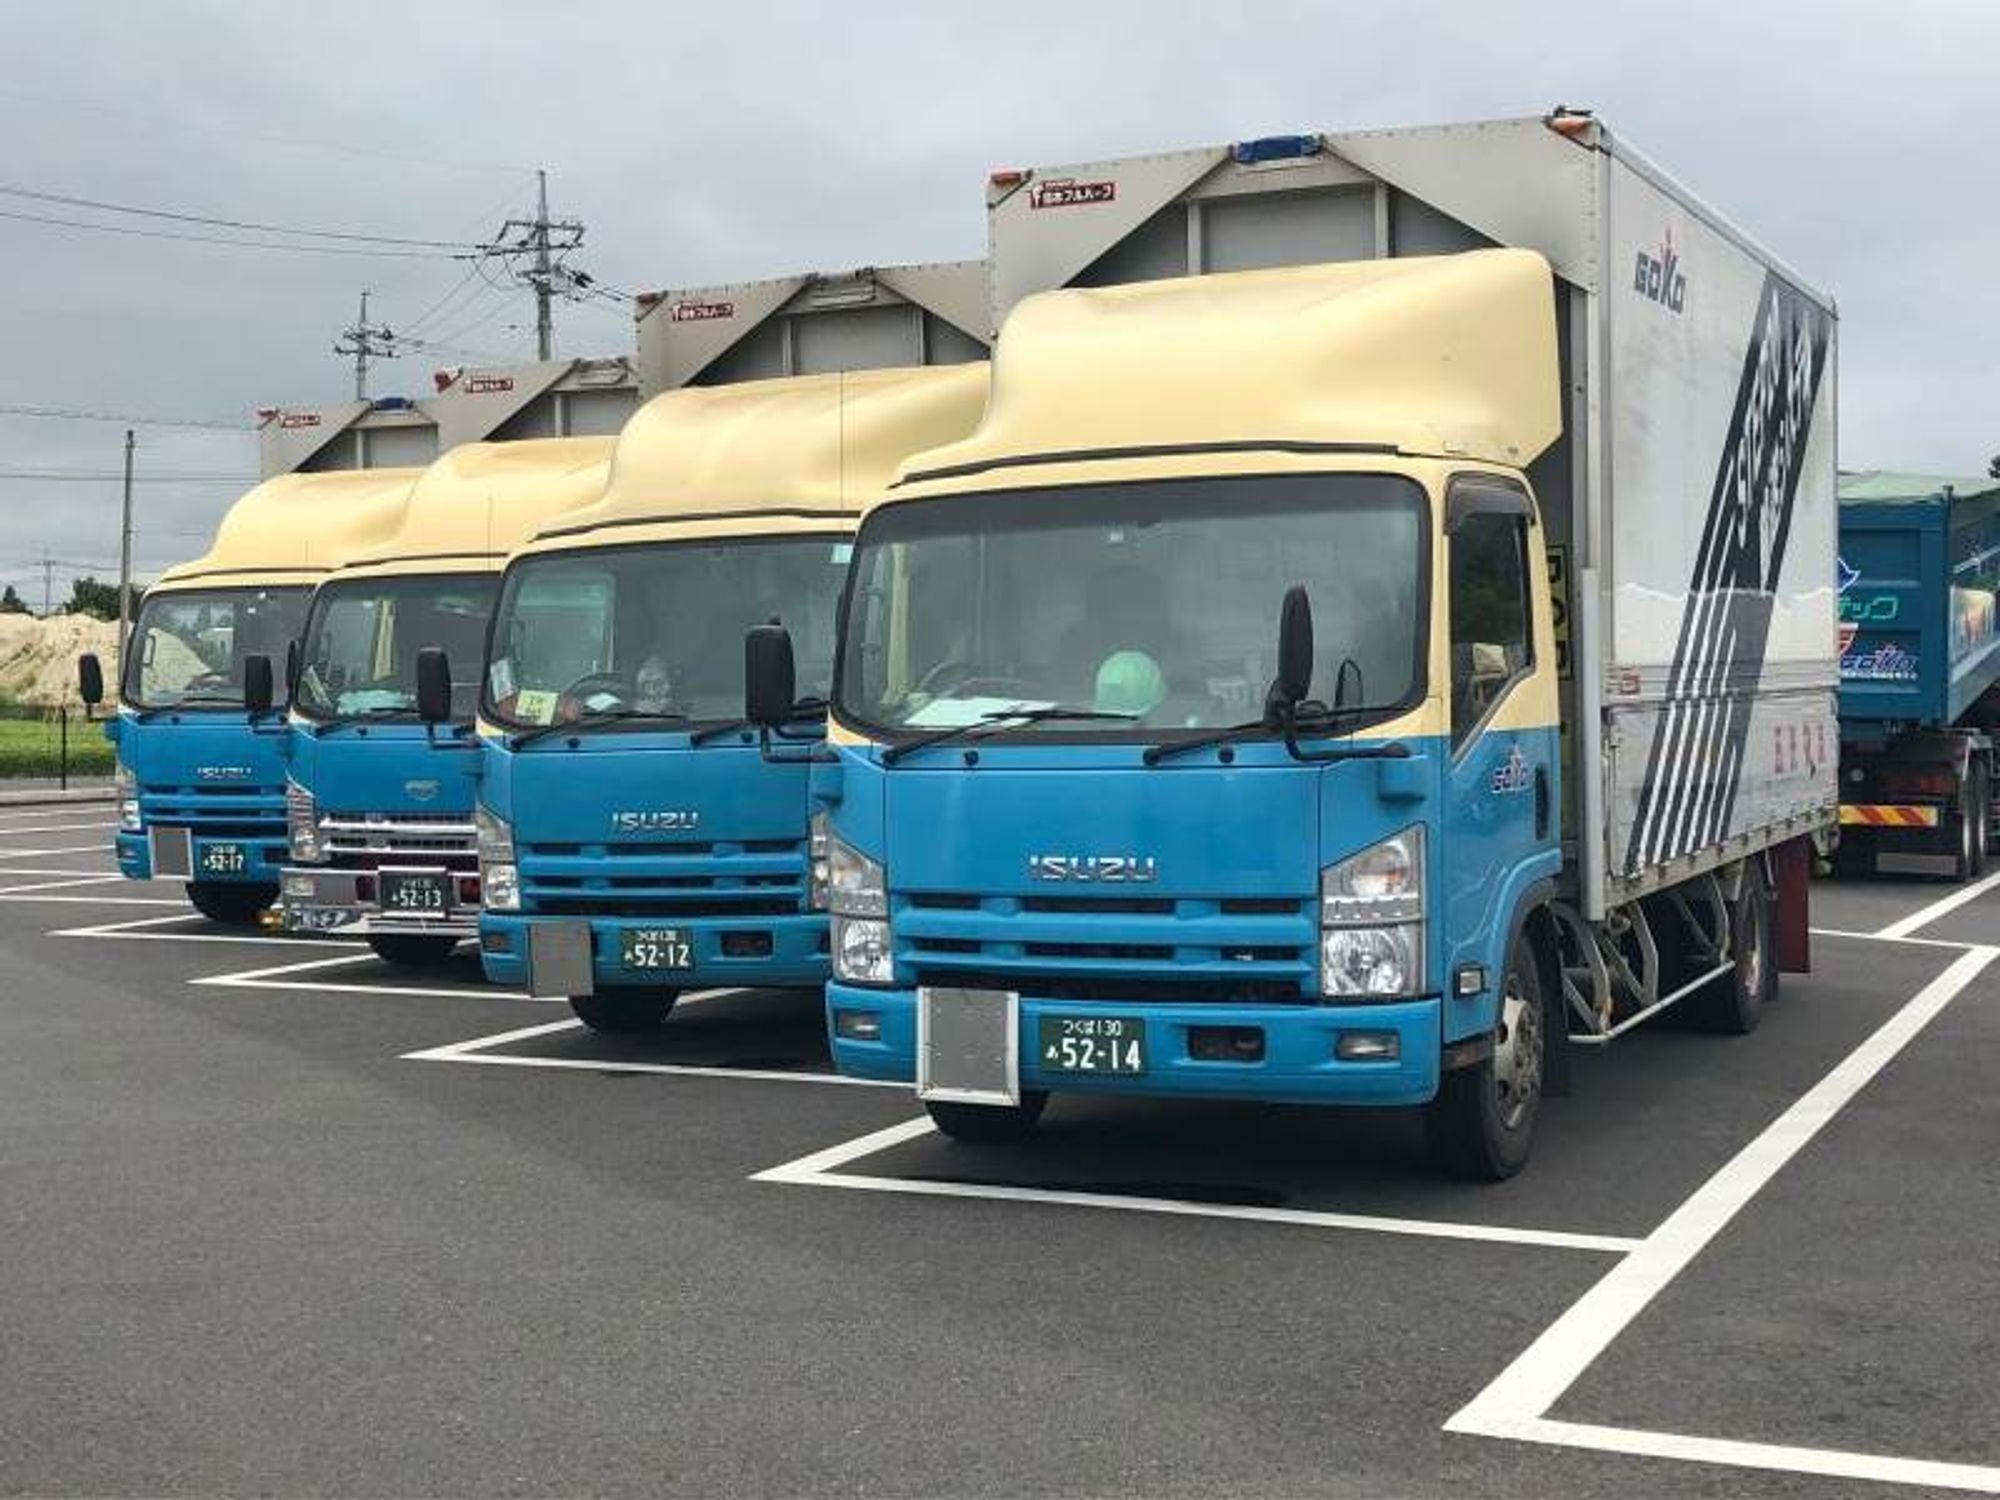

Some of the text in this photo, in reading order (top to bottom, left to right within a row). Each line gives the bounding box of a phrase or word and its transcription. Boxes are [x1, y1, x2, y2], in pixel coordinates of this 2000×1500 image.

[612, 812, 699, 831] ISUZU
[1029, 856, 1156, 882] ISUZU
[634, 944, 690, 967] 52-12
[1062, 1037, 1141, 1072] 52-14
